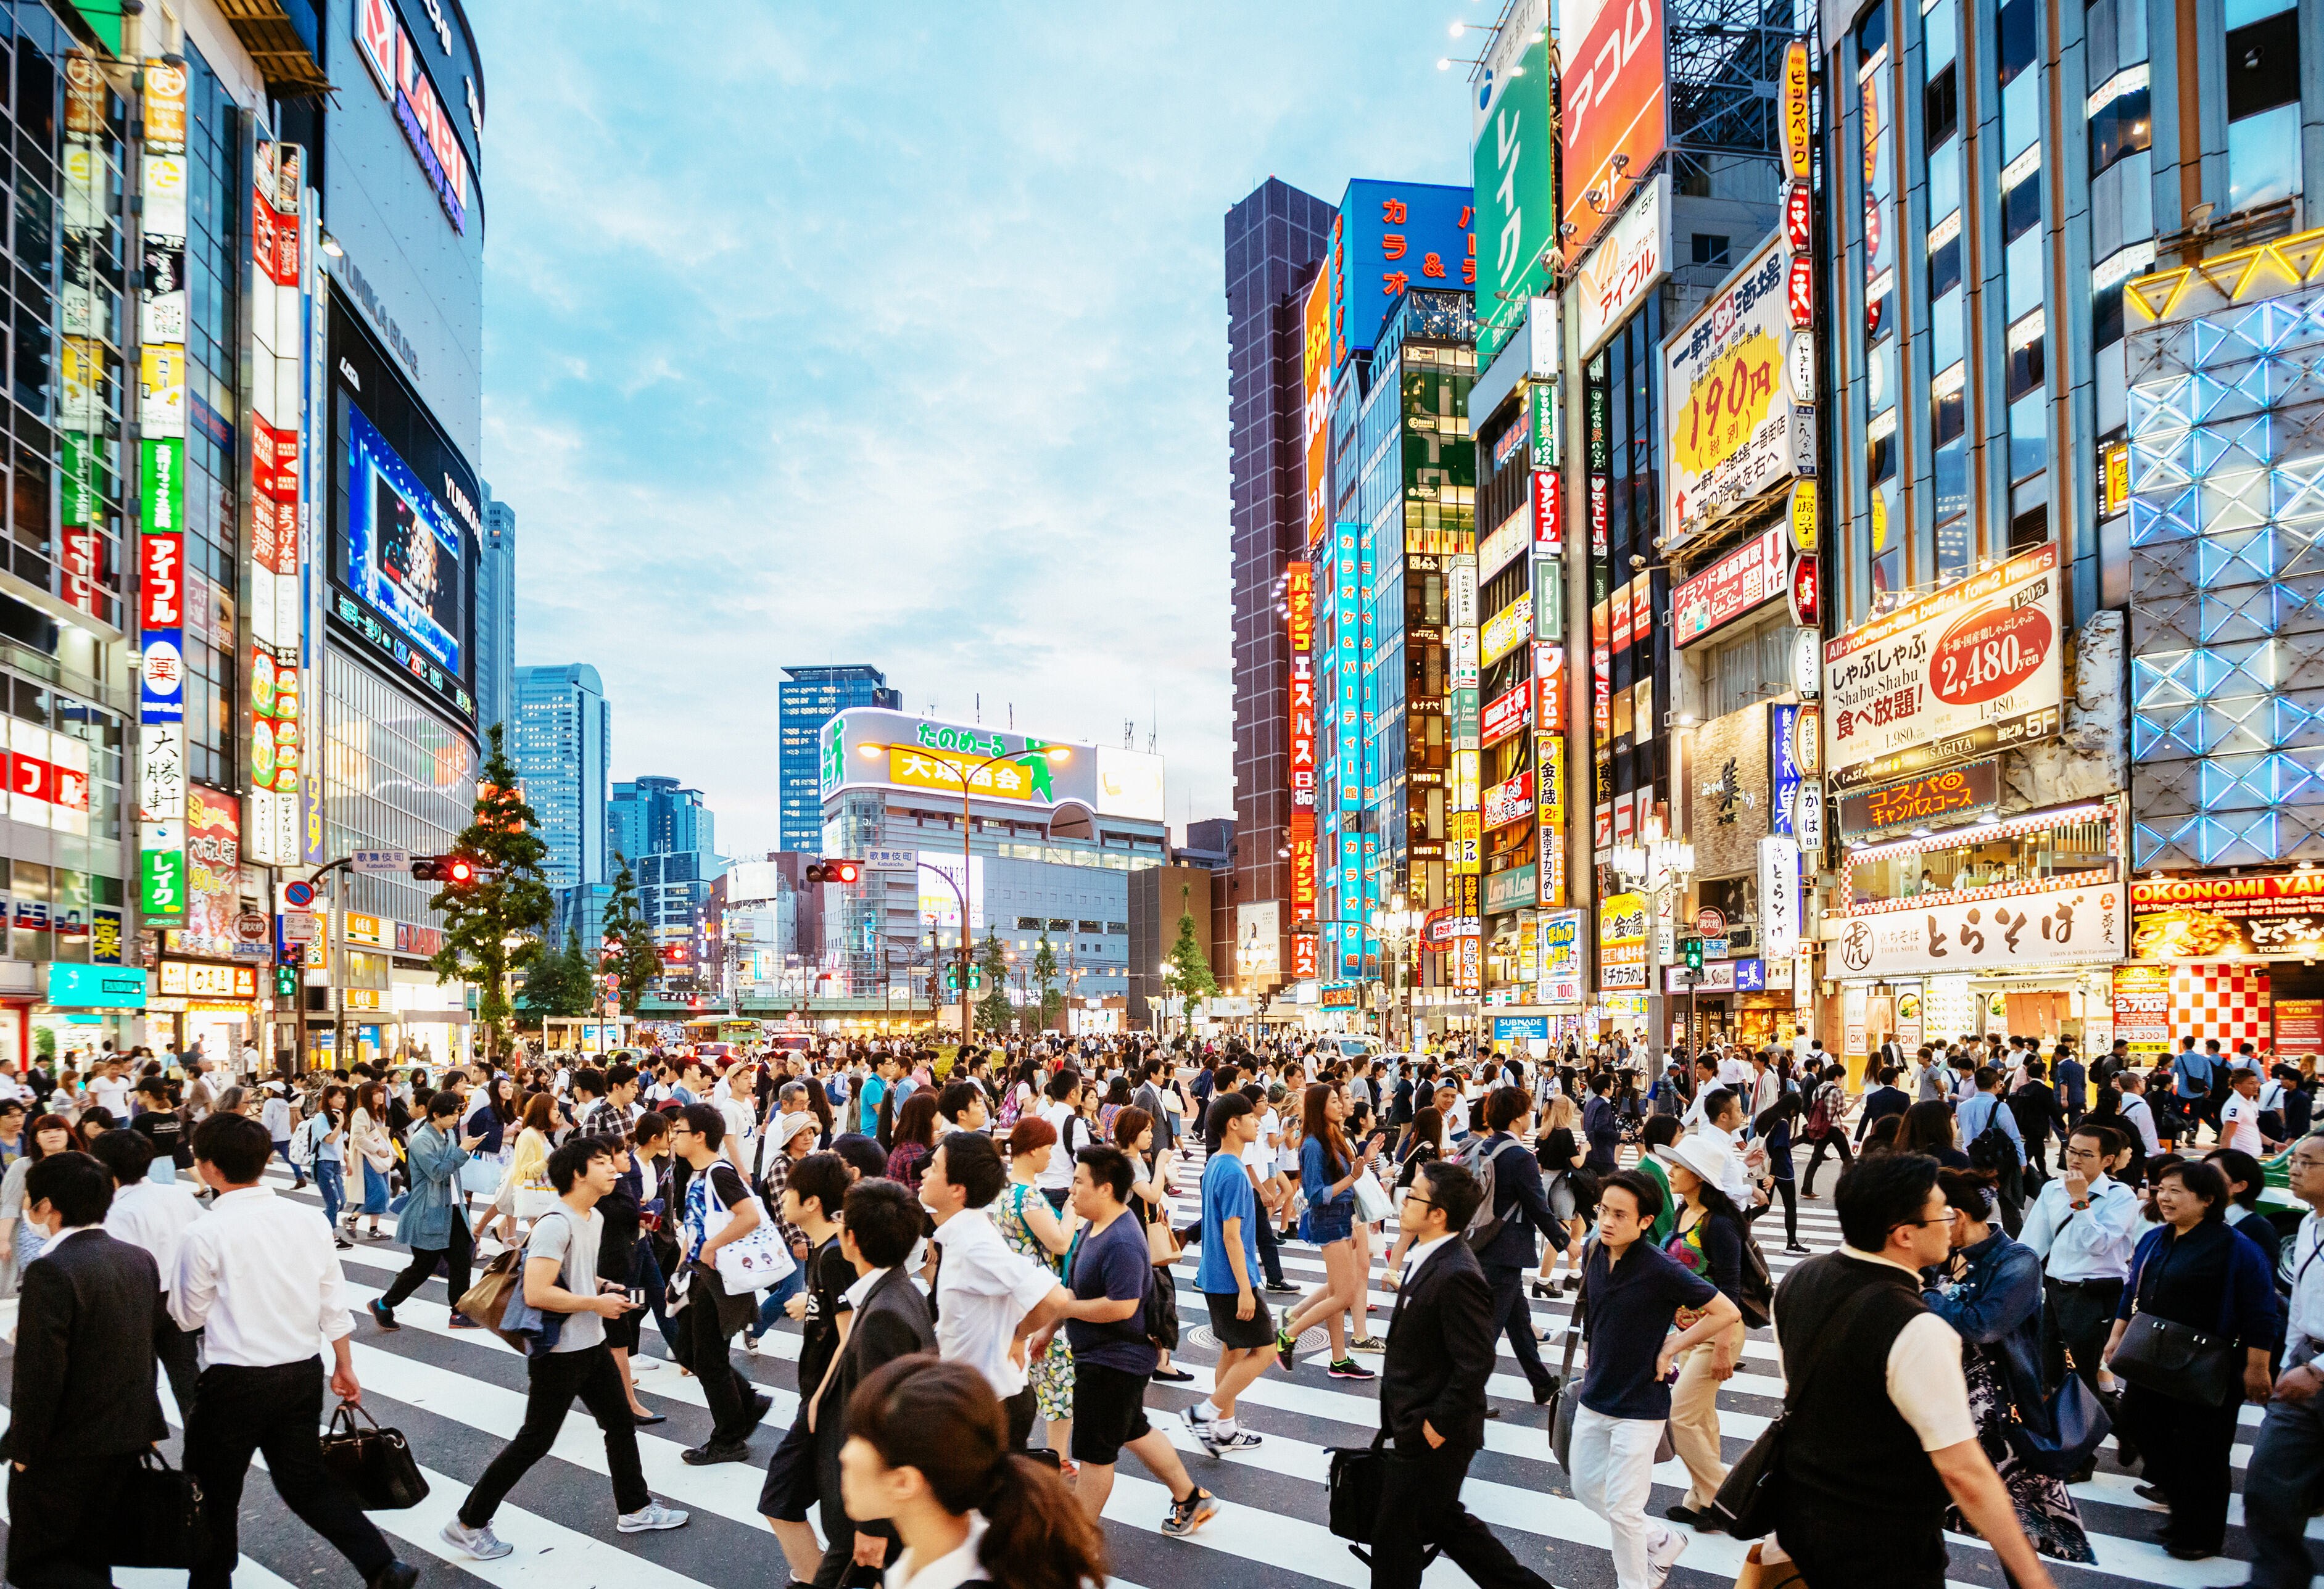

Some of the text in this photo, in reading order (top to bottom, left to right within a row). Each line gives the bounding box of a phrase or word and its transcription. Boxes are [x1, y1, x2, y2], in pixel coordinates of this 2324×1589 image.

[1497, 107, 1521, 288] レイク
[1422, 252, 1446, 278] &
[1600, 248, 1656, 326] アイフル
[1673, 253, 1781, 369] 一軒め酒場
[1799, 346, 1809, 383] ヤキトリ
[1690, 357, 1771, 452] 190円
[1690, 415, 1786, 494] 一軒め酒場一番街店
[1540, 487, 1557, 541] アイフル
[1797, 501, 1814, 535] 虎の子
[278, 505, 296, 574] まつげ本舗
[149, 539, 177, 623] アイフル
[1677, 542, 1763, 608] ブランド高価買取
[1745, 569, 1761, 584] TAX
[1745, 583, 1761, 601] FREE
[1768, 569, 1784, 591] 1F
[1293, 570, 1311, 651] パチンコ
[1797, 598, 1803, 612] 3F
[1829, 551, 2053, 660] All-you-can-eat buffet for 2 hours
[2012, 582, 2046, 611] 120分
[1942, 610, 2035, 656] 牛・豚・国産鶏しゃぶしゃぶ
[147, 657, 177, 681] 薬
[1341, 534, 1358, 800] カラオケ&パーティー館
[1832, 629, 1927, 691] しゃぶしゃぶ
[1543, 679, 1558, 717] アコム
[1803, 691, 1815, 700] 1F
[1544, 718, 1557, 727] 3F
[1996, 708, 2057, 742] 当ビル 5F
[919, 723, 1006, 757] たのめーる
[1805, 717, 1816, 767] お好み焼き
[1922, 738, 1973, 761] USAGIYA
[146, 730, 181, 814] 大勝軒
[901, 755, 1022, 790] 大塚商会
[1540, 762, 1556, 805] 金の蔵
[1544, 808, 1559, 819] 2F
[1805, 794, 1819, 833] かっぱ
[1872, 787, 1974, 827] キャンパスコース
[357, 852, 404, 862] 歌舞伎町
[869, 851, 912, 861] 歌舞伎町
[1806, 837, 1818, 846] B1
[152, 855, 174, 906] レイク
[1297, 839, 1313, 903] パチンコ
[1542, 827, 1553, 900] 東京チカラめし
[1345, 840, 1358, 967] カラオケ館
[1772, 864, 1787, 938] とらそば
[2133, 878, 2265, 902] OKONOMI
[2134, 898, 2272, 913] All-You-Can-Eat dinner with
[240, 921, 264, 933] 消火栓
[1614, 910, 1644, 940] 金の蔵
[1699, 918, 1720, 930] 消火栓
[1927, 894, 2085, 958] とらそば
[2213, 906, 2305, 917] Drinks for 2 hours
[93, 916, 121, 958] 薬
[1547, 922, 1576, 946] まんが
[1843, 921, 1871, 967] 虎
[1880, 928, 1920, 944] 立ちそば
[2101, 913, 2115, 945] 蕎麦
[1463, 938, 1478, 978] 居酒屋
[238, 970, 251, 986] 24
[1608, 967, 1645, 985] チカラめし
[1500, 1018, 1542, 1027] SUBNADE
[1850, 1033, 1865, 1044] OK!
[1901, 1033, 1919, 1044] OK!
[1499, 1043, 1507, 1054] 5
